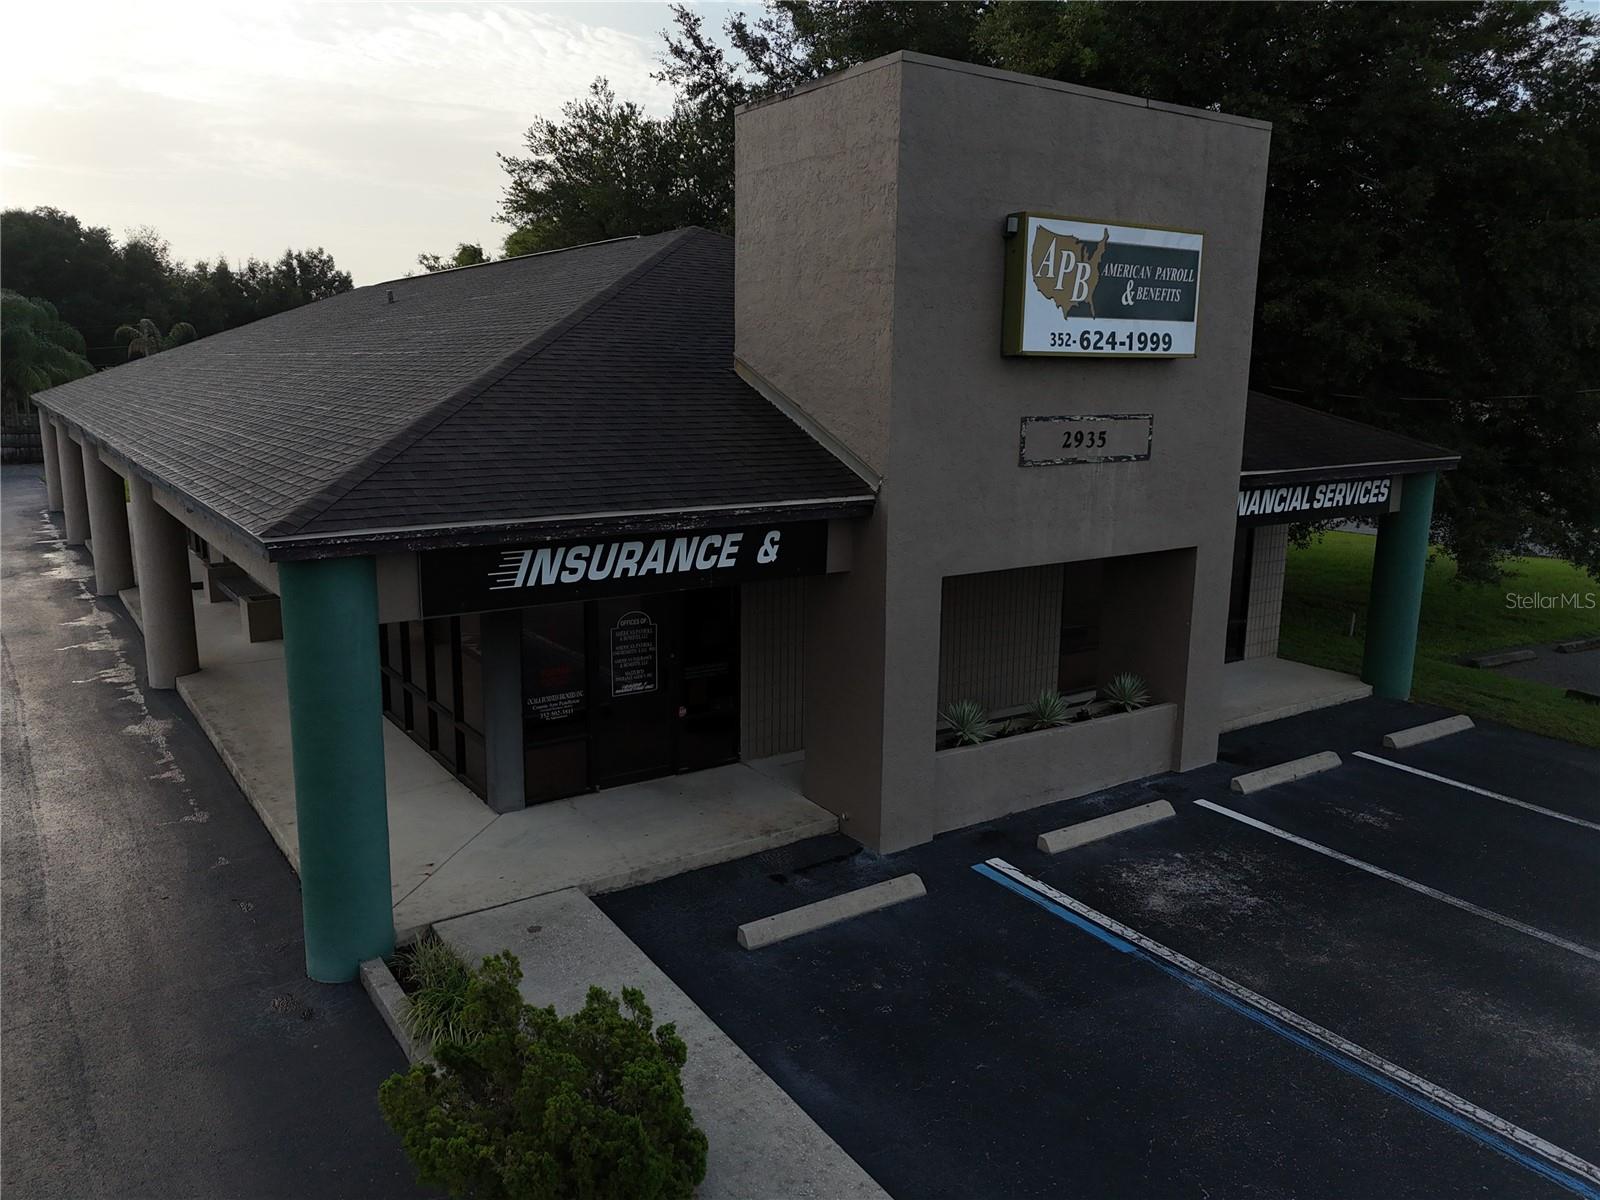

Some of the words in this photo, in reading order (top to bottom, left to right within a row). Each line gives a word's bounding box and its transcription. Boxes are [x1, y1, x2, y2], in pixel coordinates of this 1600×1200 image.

[1035, 237, 1092, 302] APB
[1101, 263, 1152, 280] AMERICAN
[1154, 266, 1195, 283] PAYROLL
[1121, 279, 1135, 306] &
[1136, 286, 1182, 302] BENEFITS
[1062, 430, 1108, 449] 2935
[1237, 485, 1311, 516] NANCIAL
[1313, 479, 1391, 509] SERVICES
[513, 532, 744, 588] INSURANCE
[756, 530, 782, 564] &
